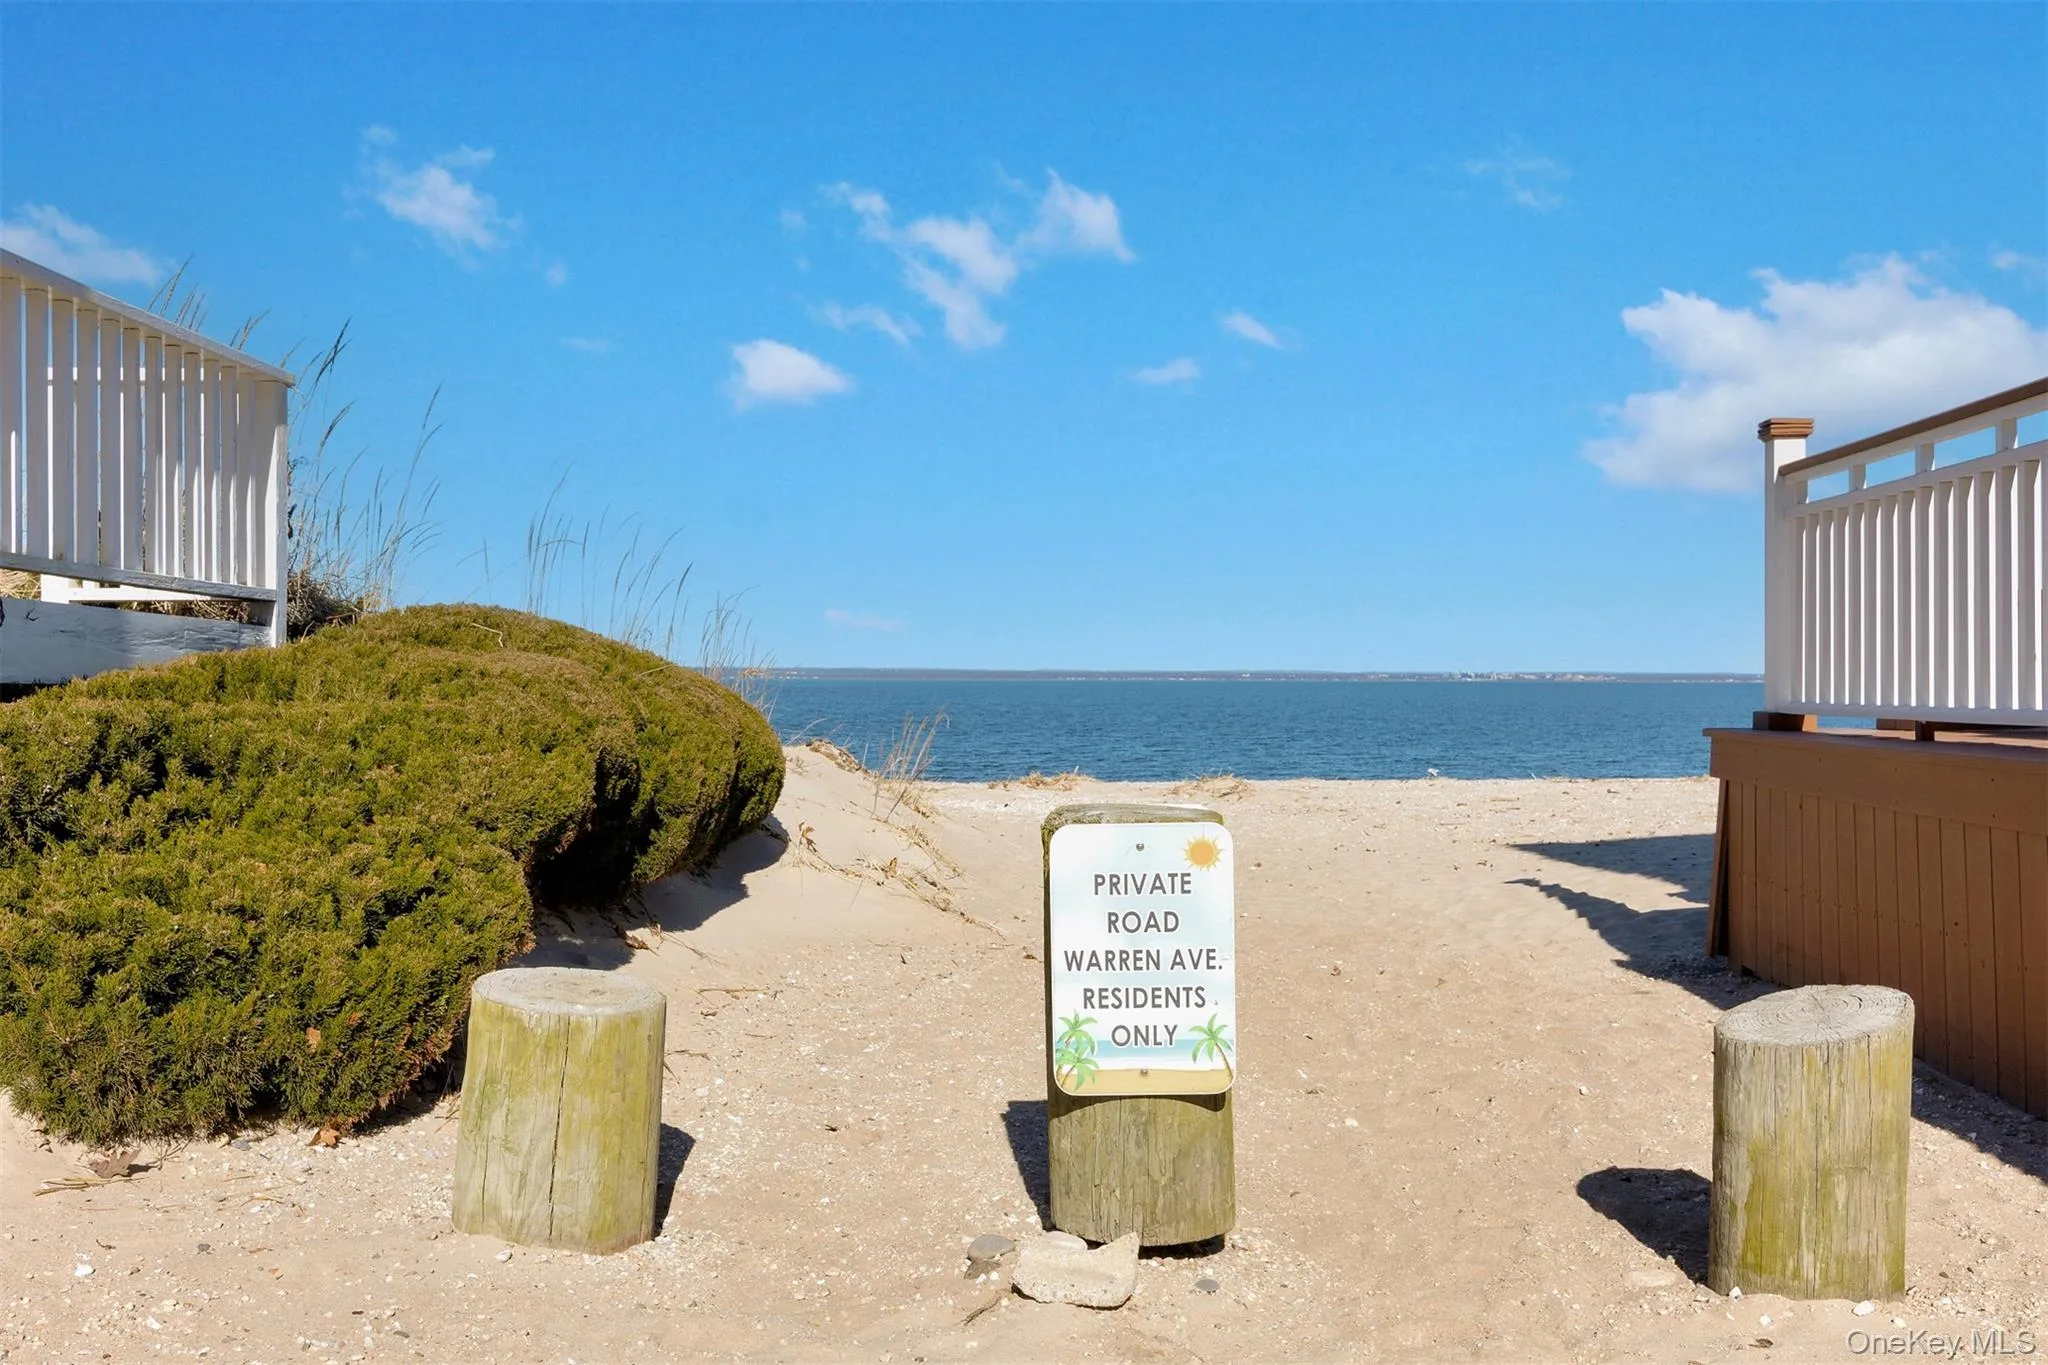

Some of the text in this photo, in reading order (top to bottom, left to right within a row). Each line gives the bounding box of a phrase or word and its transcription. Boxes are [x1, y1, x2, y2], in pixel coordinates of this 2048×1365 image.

[1094, 872, 1192, 895] PRIVATE
[1107, 911, 1180, 933] ROAD
[1064, 948, 1223, 971] WARREN AVE.
[1083, 986, 1206, 1009] RESIDENTS
[1111, 1024, 1178, 1047] ONLY
